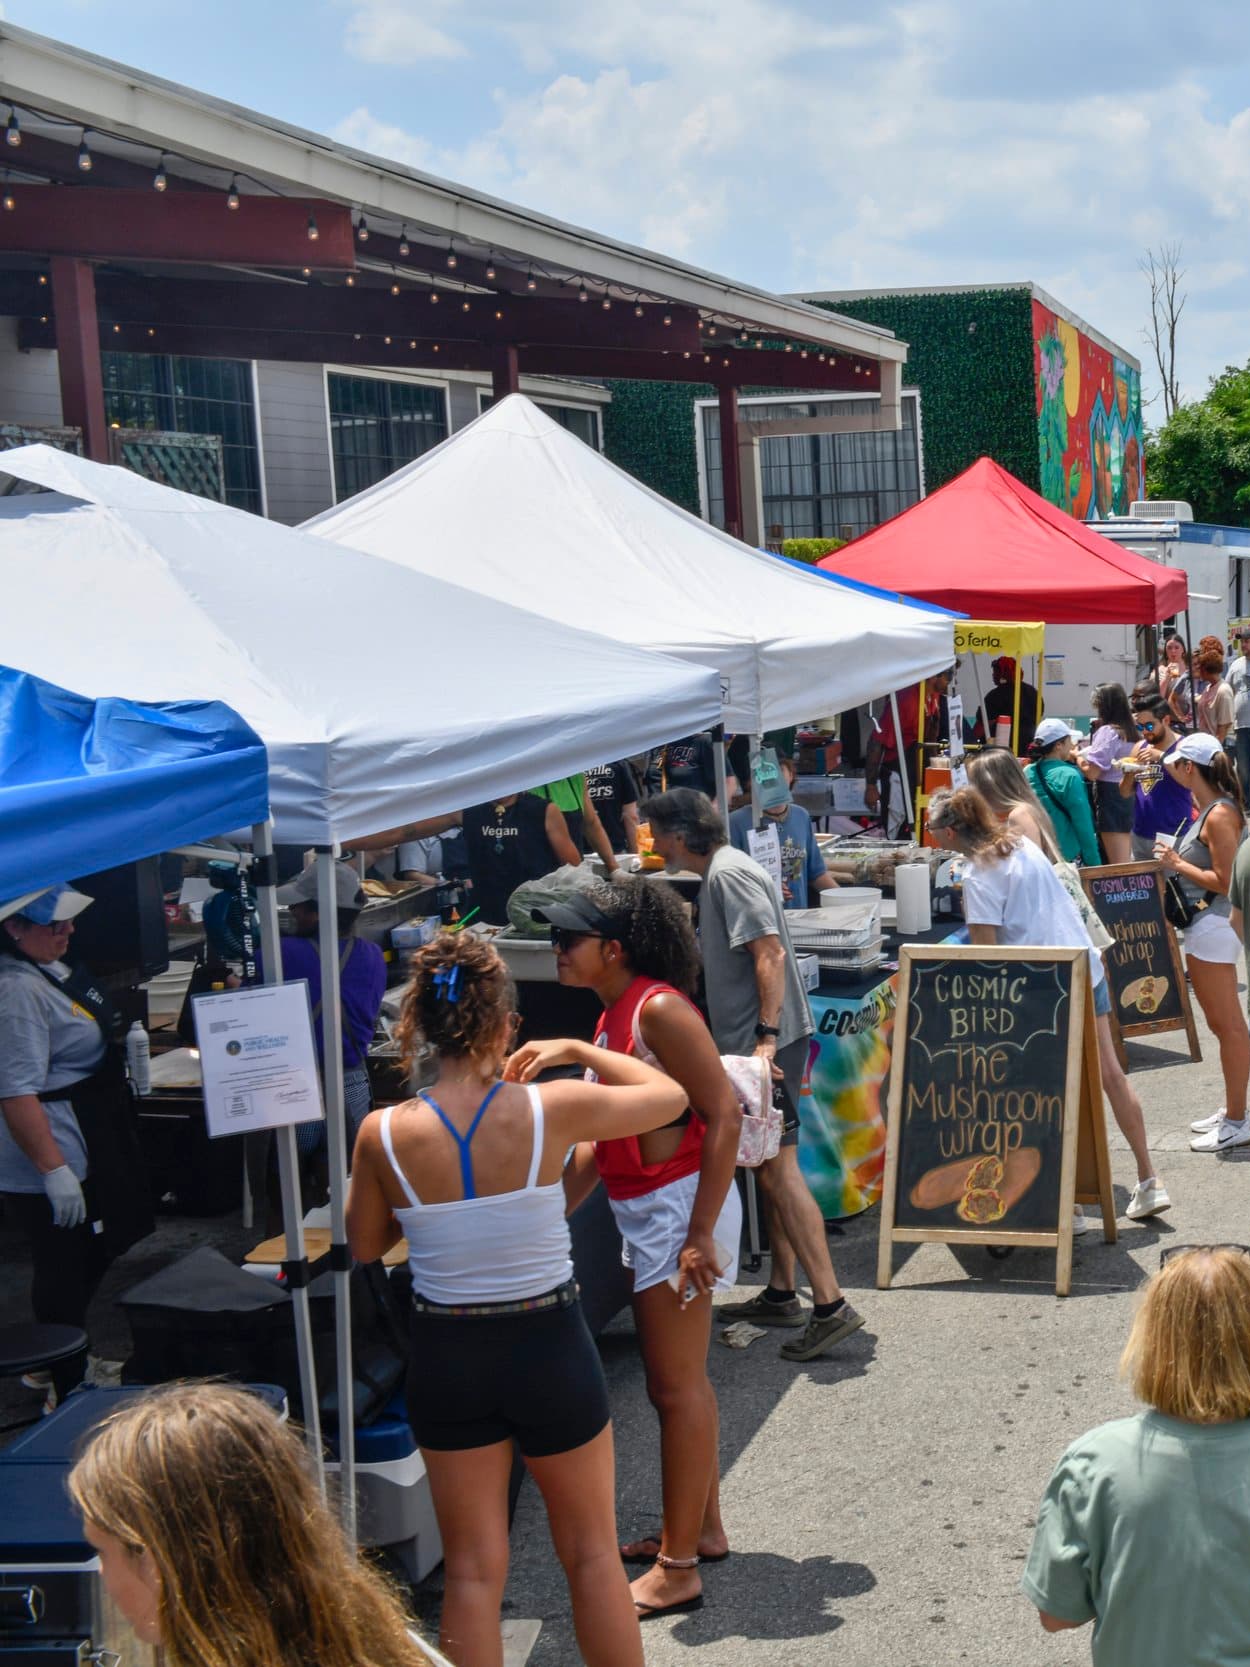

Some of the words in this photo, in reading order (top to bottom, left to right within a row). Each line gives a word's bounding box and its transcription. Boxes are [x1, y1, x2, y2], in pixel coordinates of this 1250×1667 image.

[481, 825, 518, 838] Vegan
[1129, 875, 1154, 890] BIRD
[1106, 919, 1161, 943] ushroom
[906, 1080, 1063, 1131] Mushroom
